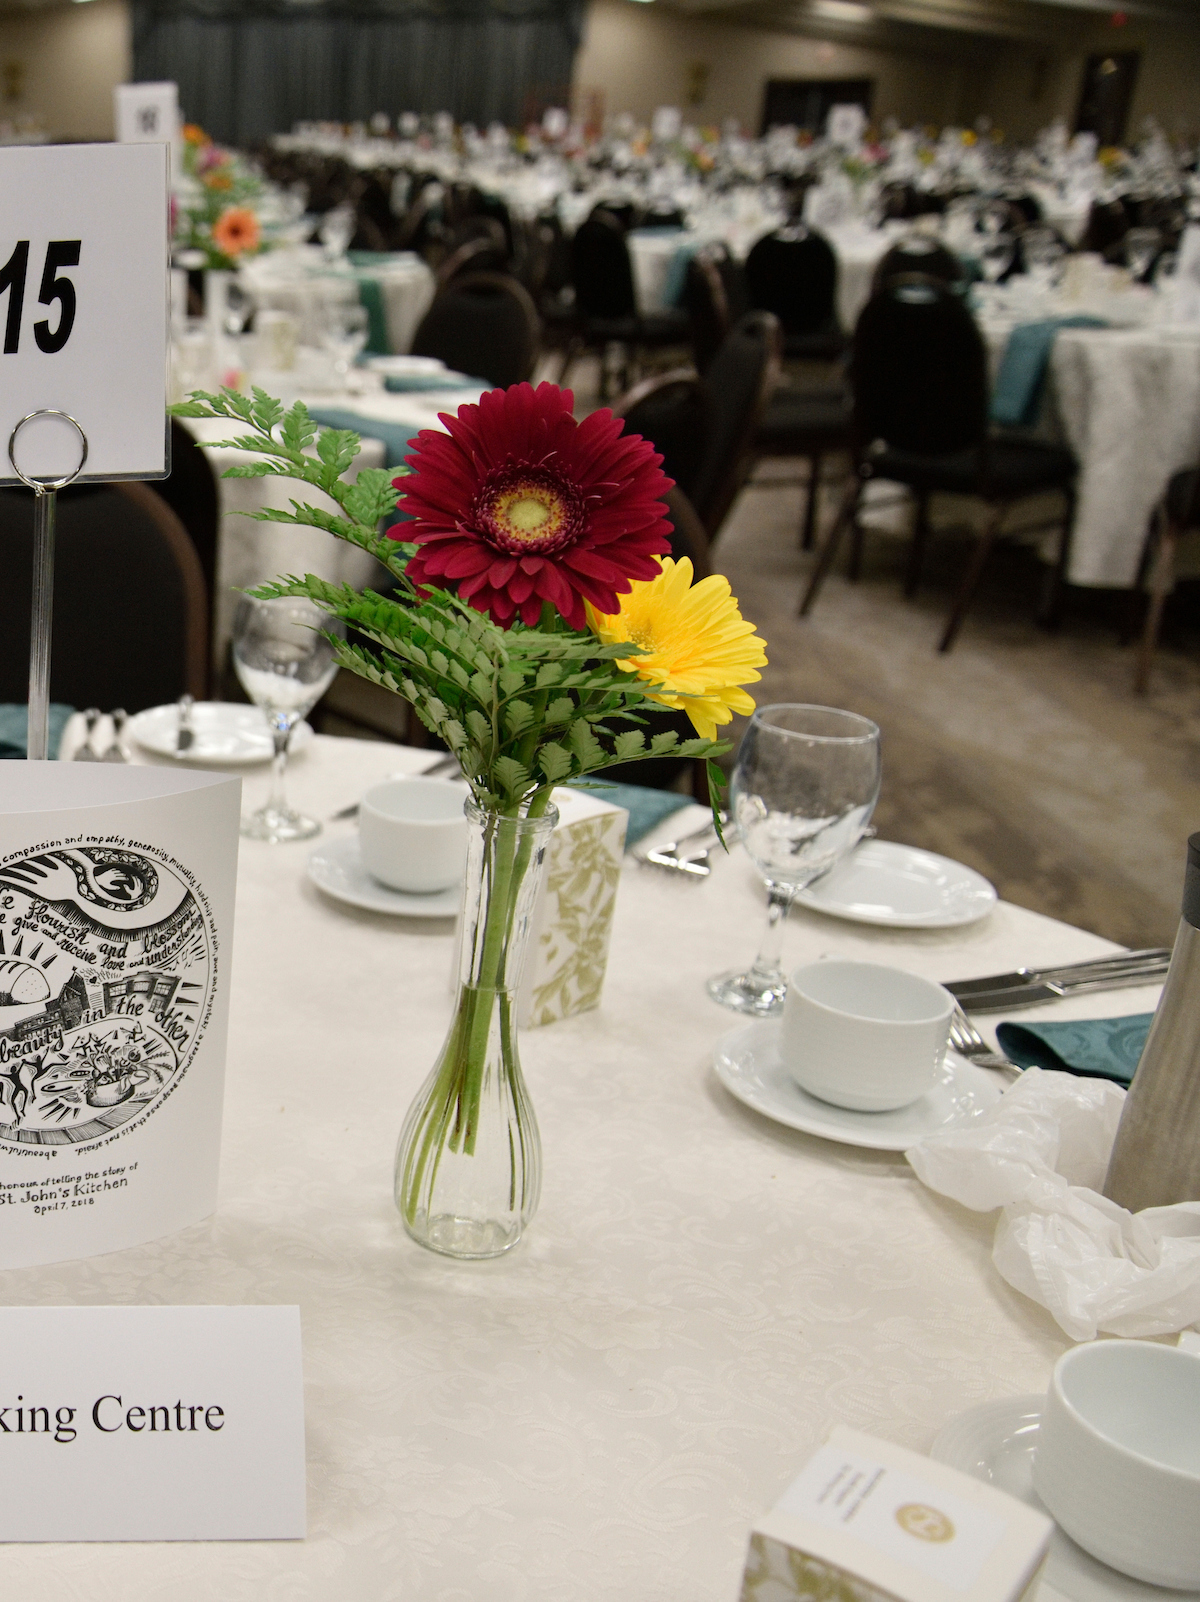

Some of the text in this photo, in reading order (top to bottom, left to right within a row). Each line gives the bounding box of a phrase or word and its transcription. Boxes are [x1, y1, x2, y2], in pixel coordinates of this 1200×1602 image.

[2, 840, 62, 864] compassion
[65, 834, 83, 844] and
[86, 834, 125, 847] empathy,
[169, 857, 197, 887] mutuality,
[25, 899, 90, 946] flourish
[99, 941, 129, 959] and
[142, 909, 197, 955] blossom
[208, 916, 218, 934] and
[11, 916, 39, 936] give
[41, 928, 60, 941] and
[56, 938, 97, 965] receive
[100, 956, 125, 971] love
[129, 957, 144, 968] and
[145, 913, 204, 966] understanding
[84, 1008, 106, 1024] in
[116, 994, 145, 1016] the
[154, 1007, 190, 1053] other
[105, 1132, 120, 1146] not
[40, 1178, 51, 1187] of
[51, 1174, 82, 1184] telling
[84, 1171, 100, 1180] the
[102, 1165, 126, 1177] story
[129, 1161, 138, 1171] of
[20, 1187, 70, 1204] John's
[73, 1177, 128, 1197] Kitchen
[60, 1201, 69, 1211] 7,
[71, 1197, 95, 1208] 2018
[91, 1394, 226, 1433] Centre
